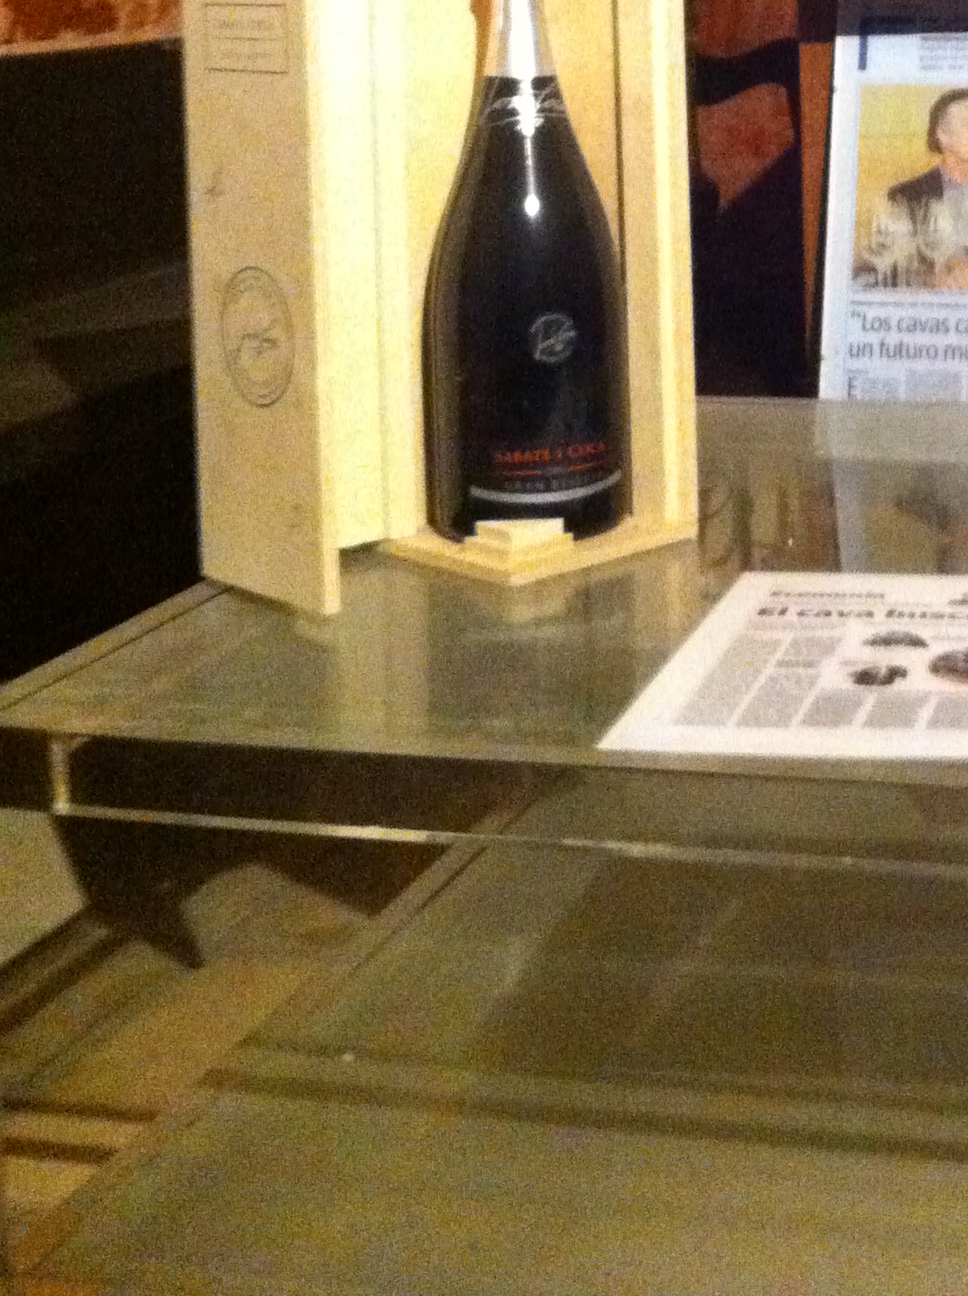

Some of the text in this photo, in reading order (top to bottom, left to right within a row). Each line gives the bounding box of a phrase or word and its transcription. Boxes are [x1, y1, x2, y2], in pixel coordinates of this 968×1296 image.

[896, 315, 950, 335] cavas
[849, 341, 873, 360] un
[878, 337, 939, 361] futuro
